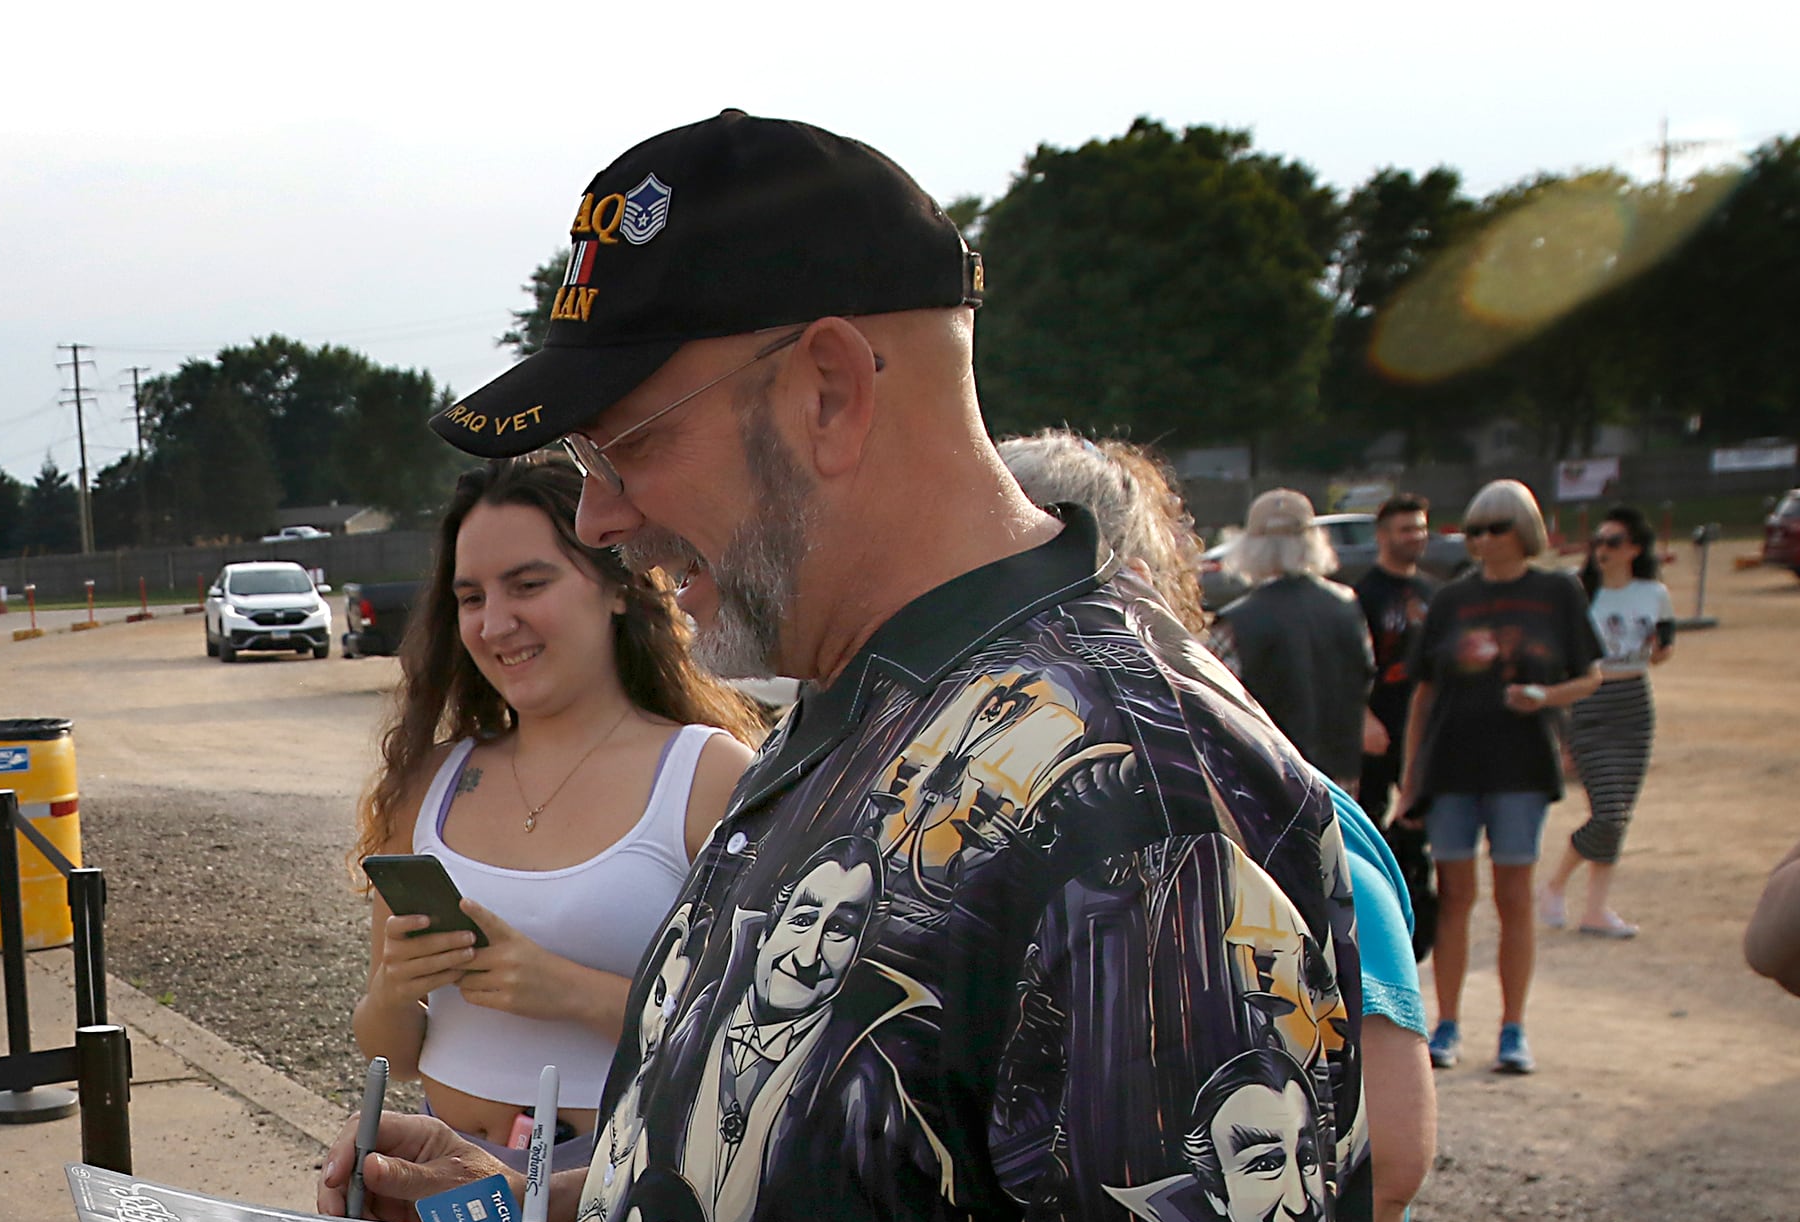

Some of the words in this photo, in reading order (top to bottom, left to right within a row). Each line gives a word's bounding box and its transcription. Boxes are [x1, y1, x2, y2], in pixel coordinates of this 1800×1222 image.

[445, 403, 487, 435] IRAQ
[495, 403, 546, 435] VET
[526, 1144, 543, 1196] Sharpie
